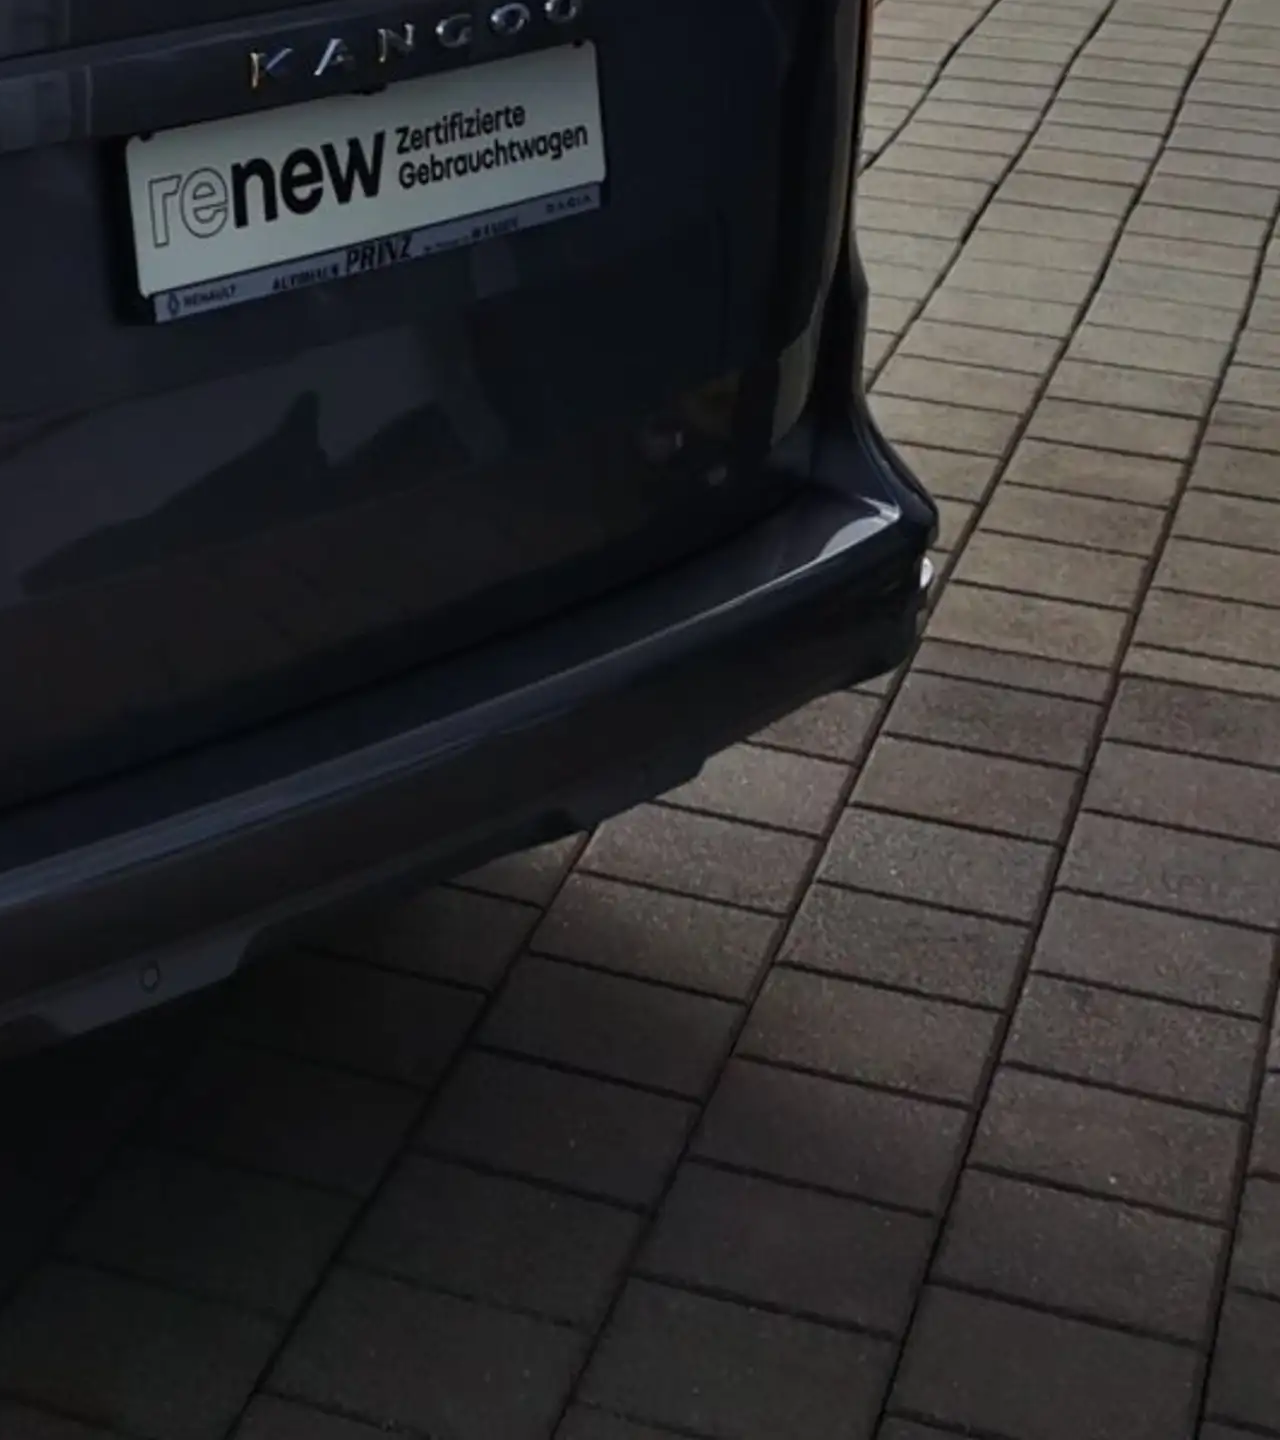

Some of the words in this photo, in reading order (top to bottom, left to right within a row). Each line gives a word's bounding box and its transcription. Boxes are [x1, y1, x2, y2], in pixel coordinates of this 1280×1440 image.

[394, 101, 527, 157] Zertifizierte
[397, 123, 589, 190] Gebrauchtwagen
[147, 130, 387, 249] renew
[545, 192, 594, 216] DACIA
[344, 234, 415, 275] PRINZ
[183, 283, 238, 310] RENAULT
